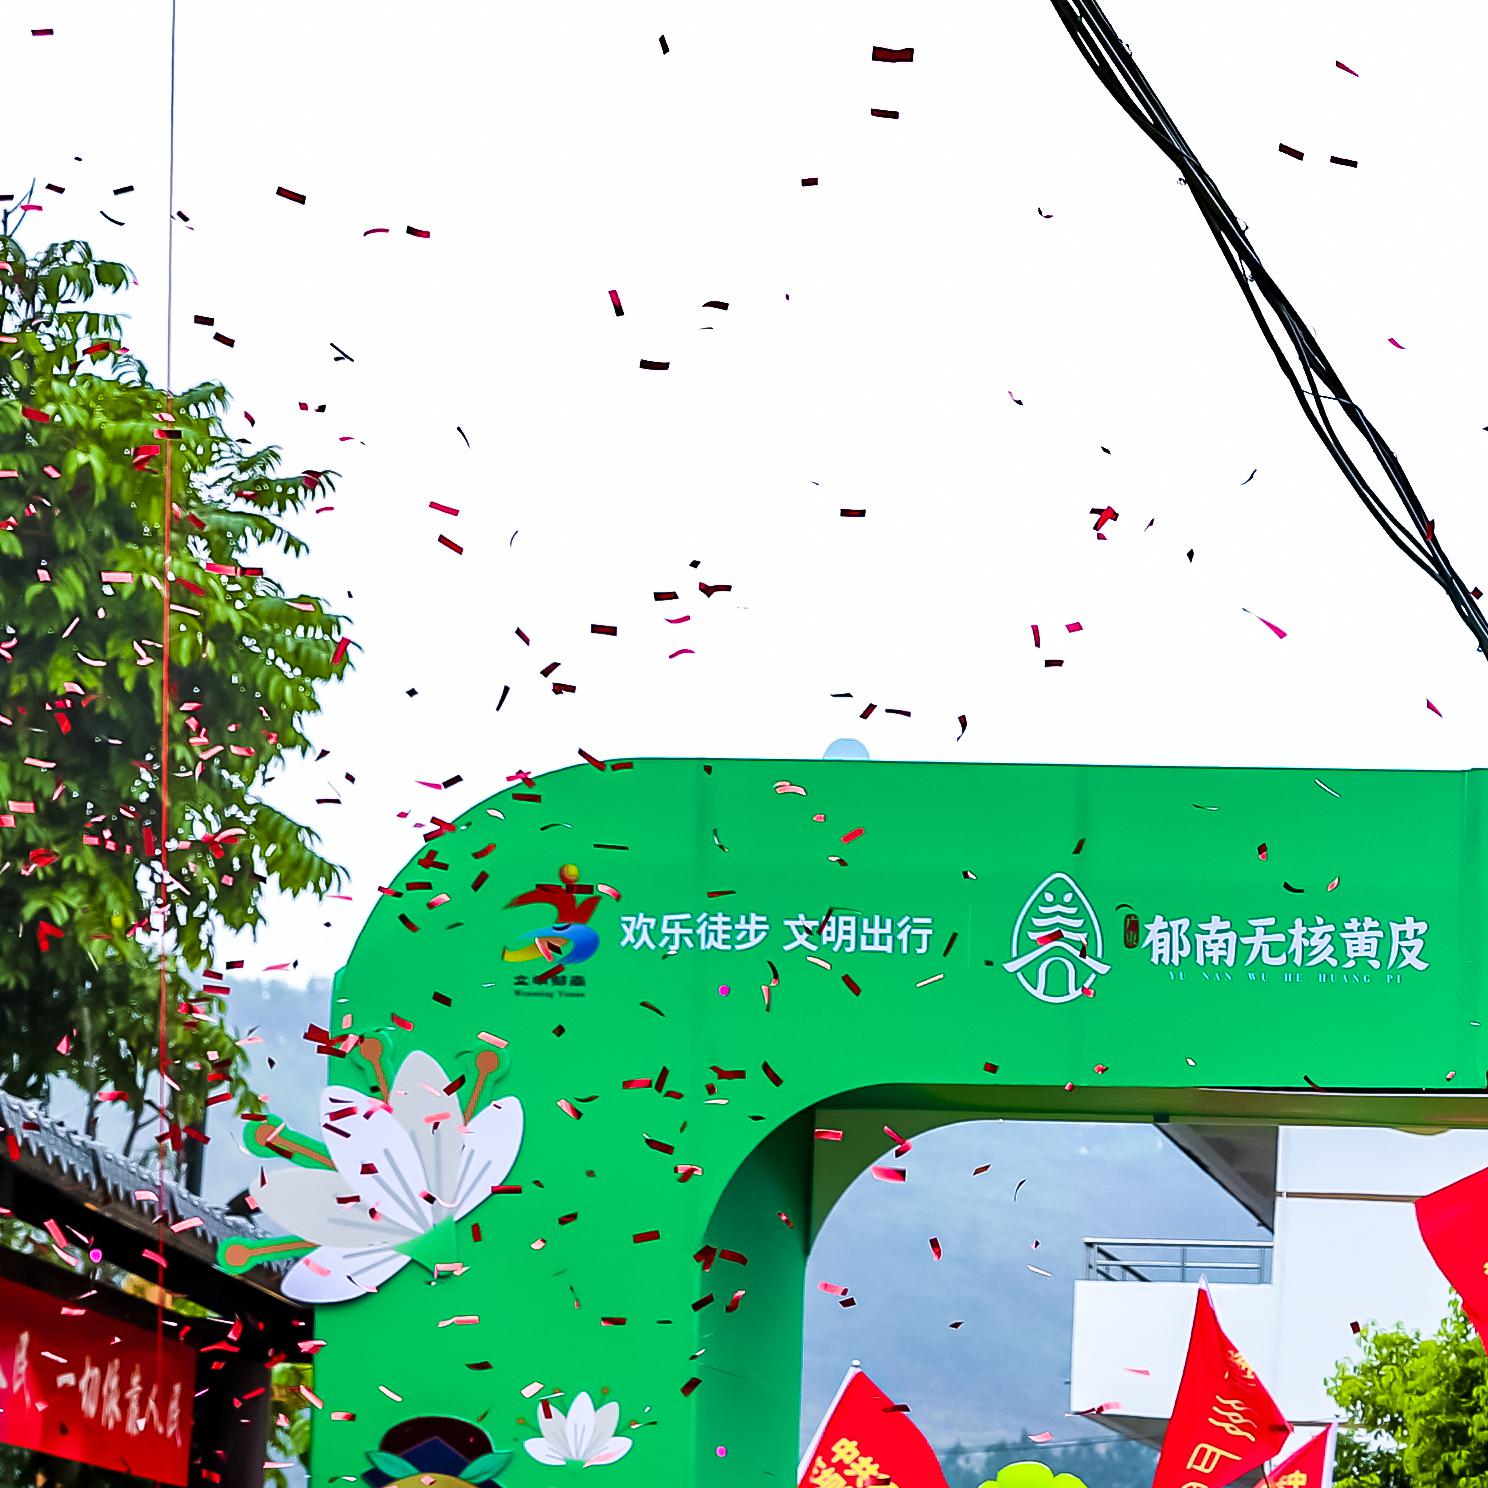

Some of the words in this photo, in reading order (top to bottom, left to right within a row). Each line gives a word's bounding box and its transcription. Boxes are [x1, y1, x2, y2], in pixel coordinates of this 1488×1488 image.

[621, 912, 770, 951] 欢乐徒步
[783, 914, 933, 953] 文明出行
[1143, 914, 1429, 970] 郁南无核黄皮
